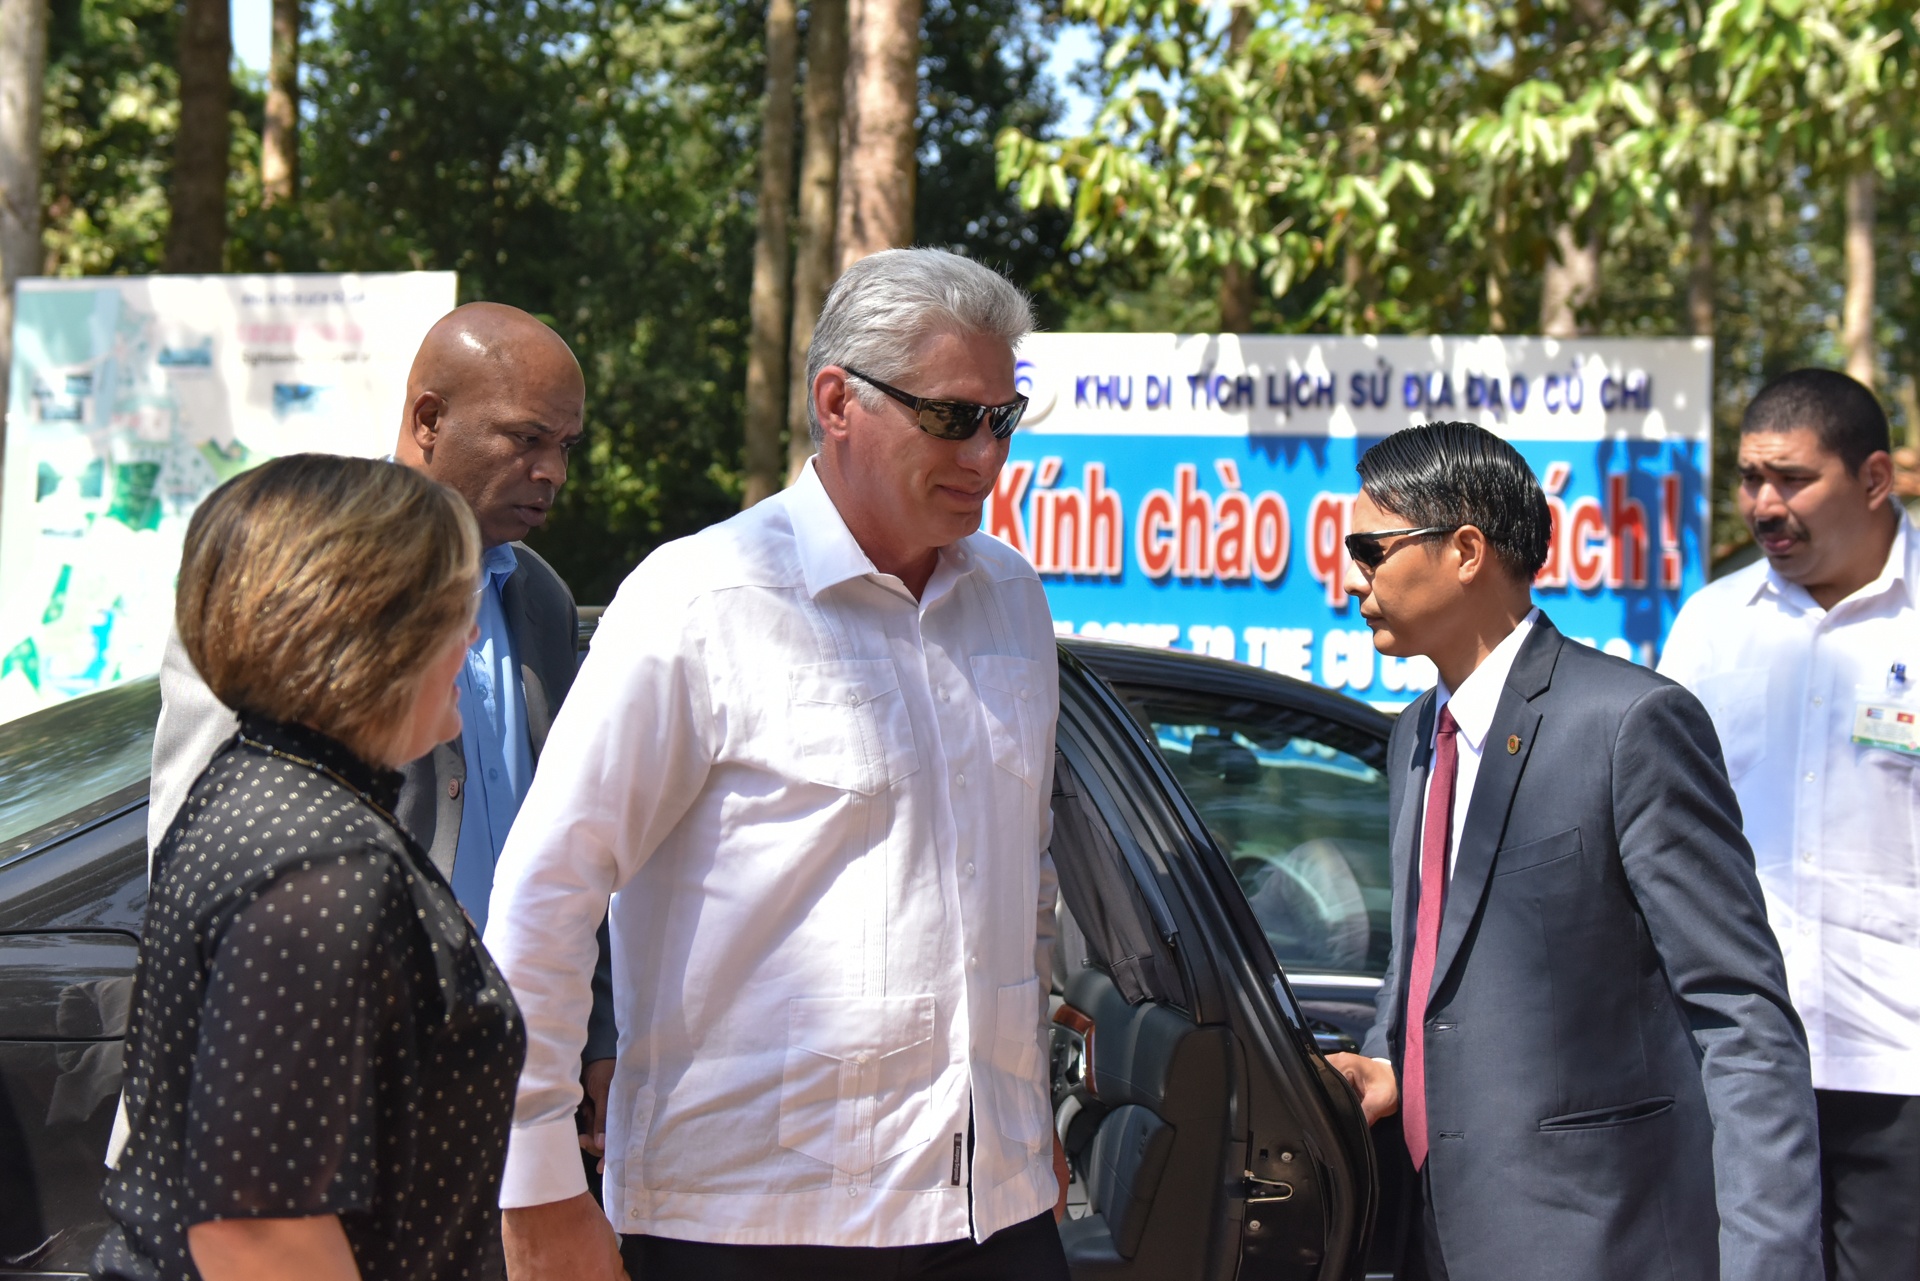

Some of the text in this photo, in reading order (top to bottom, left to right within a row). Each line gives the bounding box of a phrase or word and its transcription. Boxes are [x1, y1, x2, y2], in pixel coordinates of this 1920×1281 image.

[1075, 374, 1133, 410] KHU
[1146, 374, 1171, 410] DI
[1267, 373, 1335, 418] LỊCH
[985, 456, 1123, 577] Kính
[1135, 458, 1291, 581] chào
